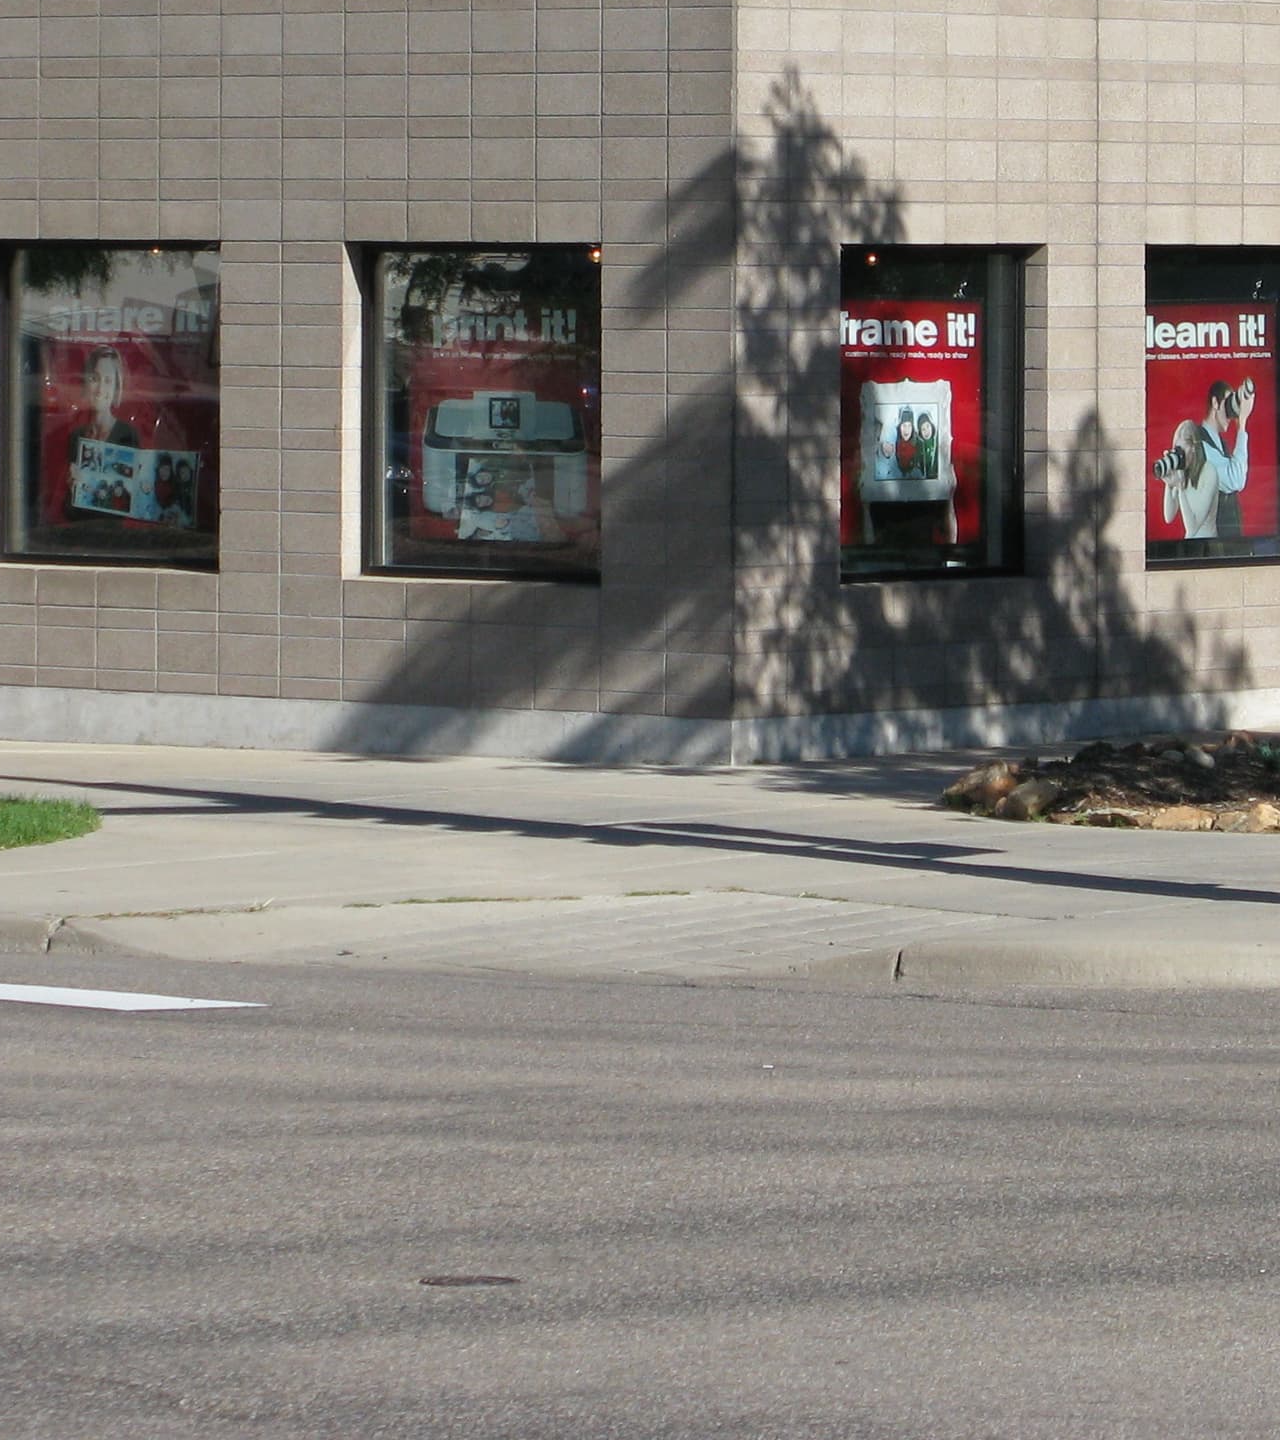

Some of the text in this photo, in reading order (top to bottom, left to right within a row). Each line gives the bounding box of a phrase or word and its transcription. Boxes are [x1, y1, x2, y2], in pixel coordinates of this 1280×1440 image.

[47, 299, 164, 332] share
[432, 308, 577, 349] print it!
[840, 311, 975, 347] frame it!
[1146, 314, 1265, 349] learn it!
